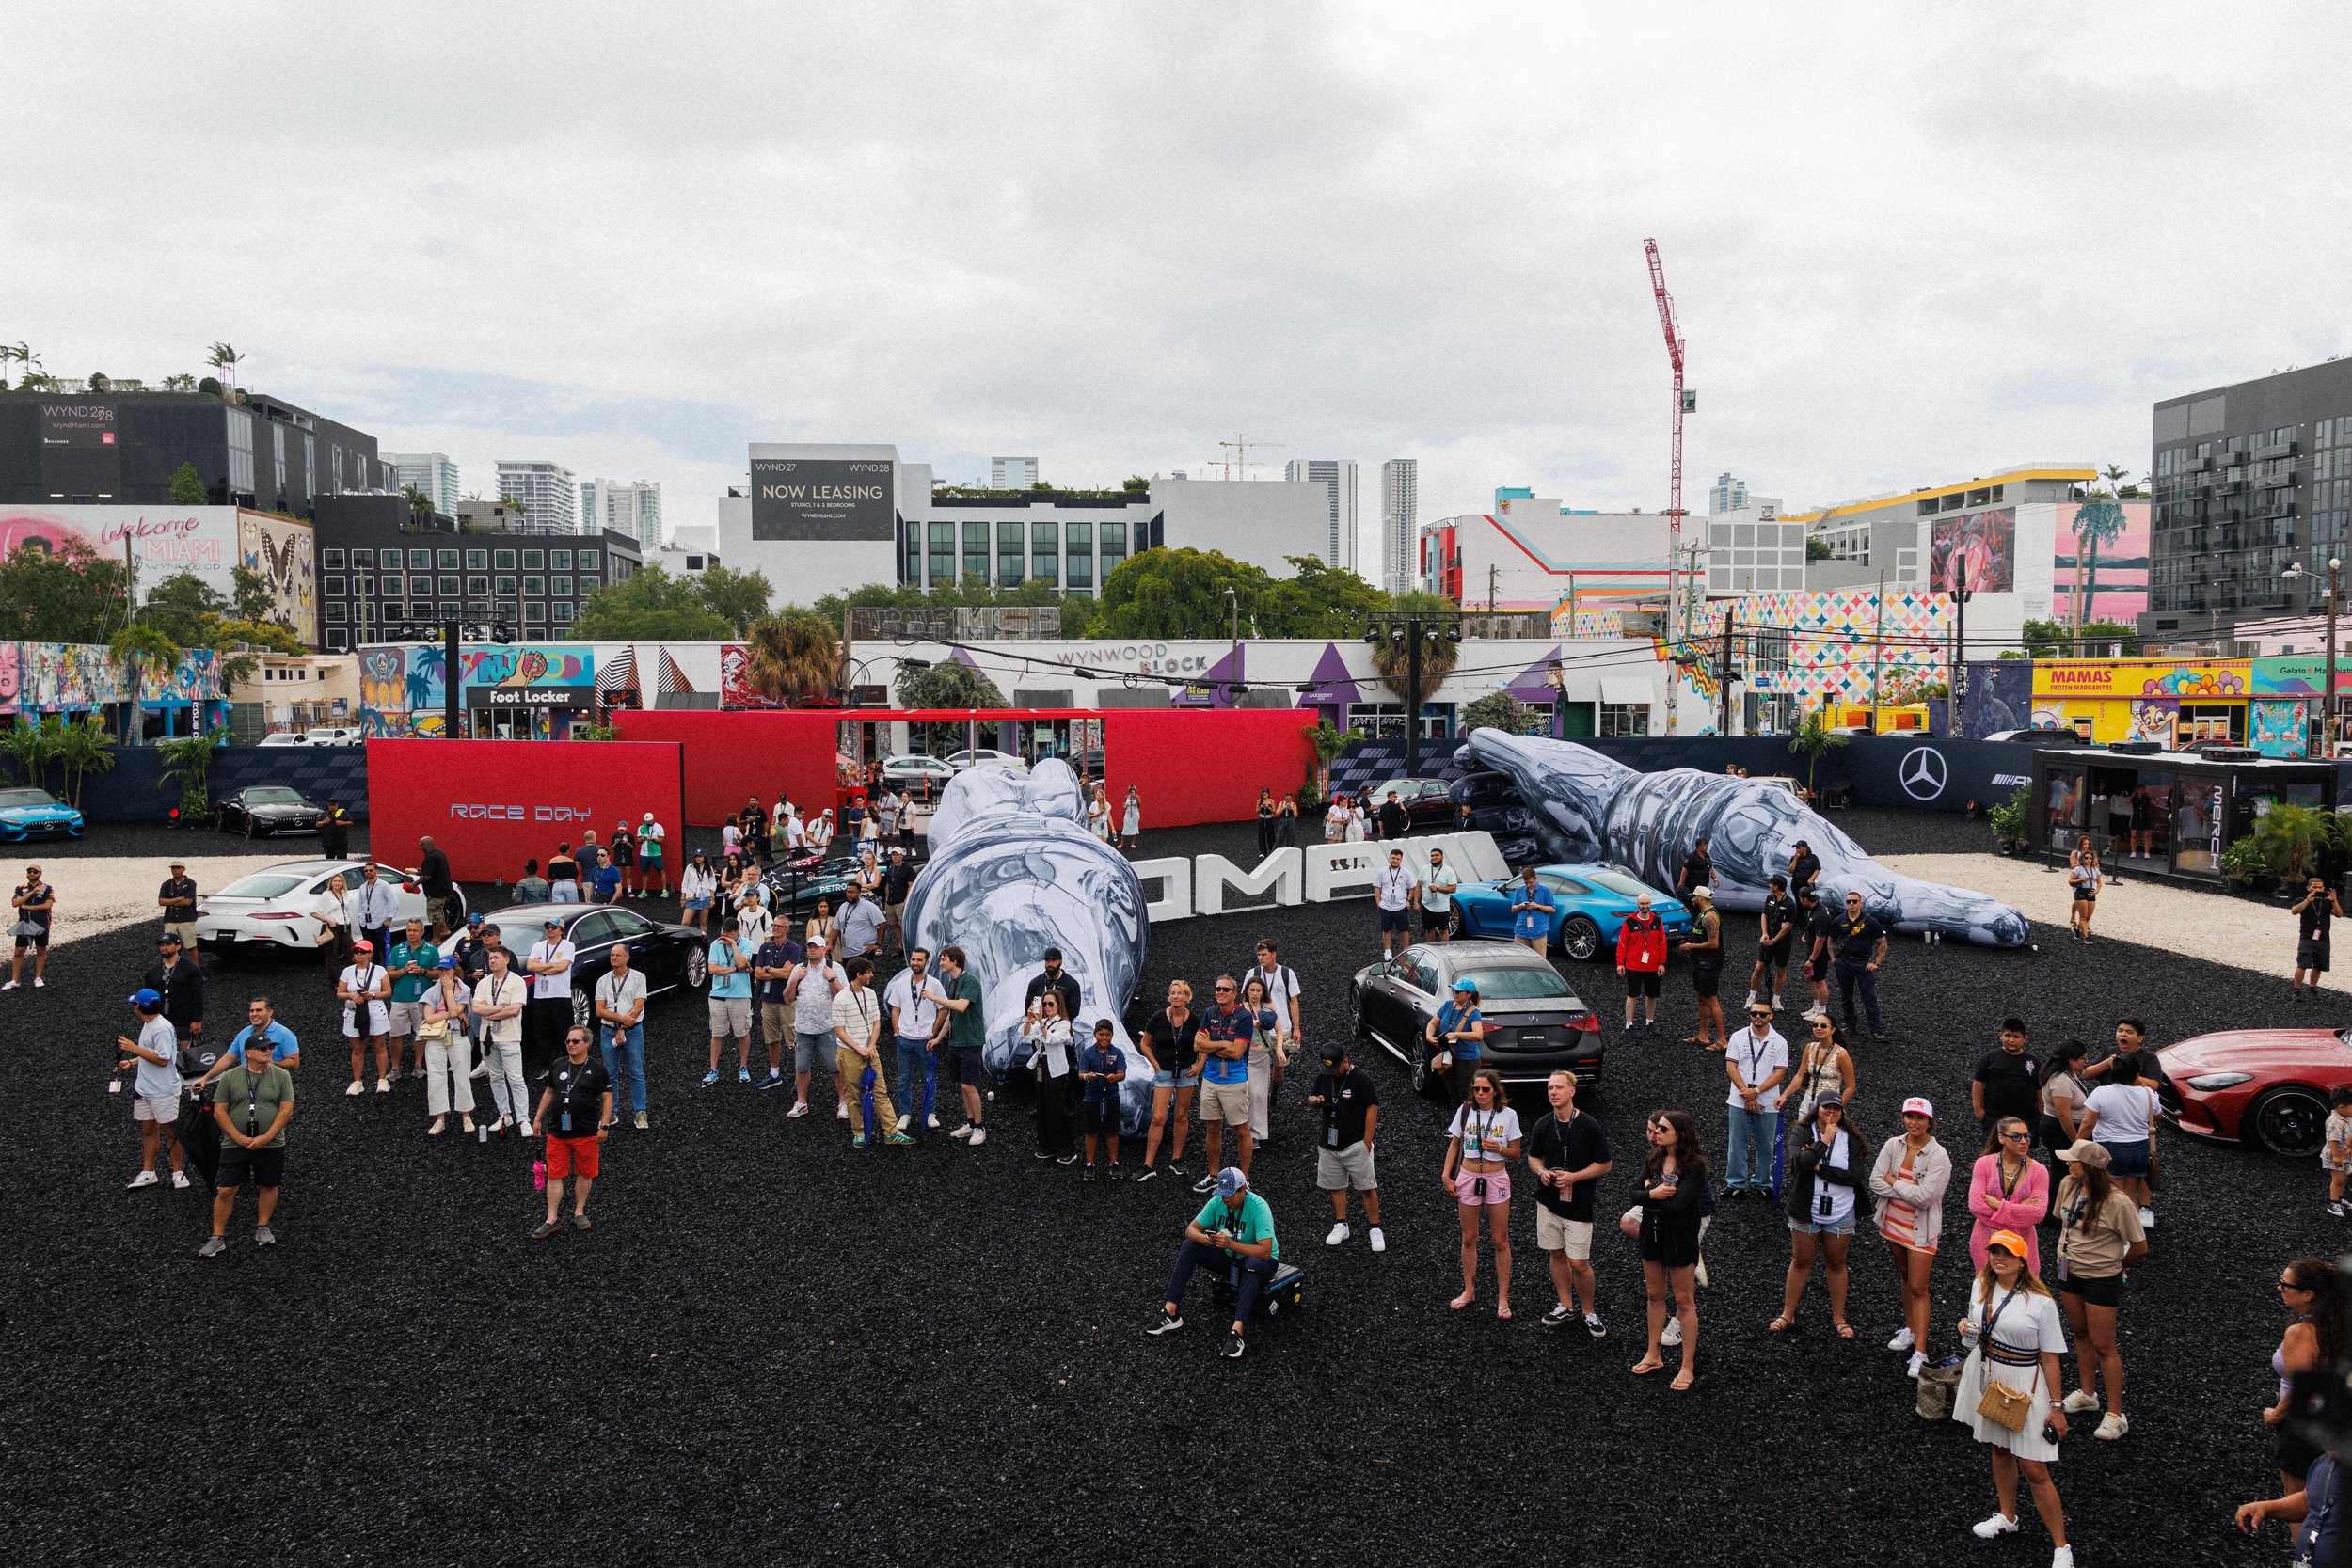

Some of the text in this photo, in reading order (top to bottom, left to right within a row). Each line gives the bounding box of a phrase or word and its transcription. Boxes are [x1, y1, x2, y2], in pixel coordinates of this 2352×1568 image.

[43, 406, 88, 417] WYND
[763, 485, 882, 499] NOW LEASING
[102, 515, 199, 544] Welcome
[145, 539, 220, 562] MIAMI
[1057, 644, 1168, 664] WYNWOOD
[2051, 670, 2112, 683] MAMAS
[489, 690, 570, 704] Foot Locker
[451, 803, 592, 822] RACE DAY
[2210, 785, 2223, 870] MERCH
[787, 859, 812, 867] INEOS
[819, 883, 848, 894] PETRO
